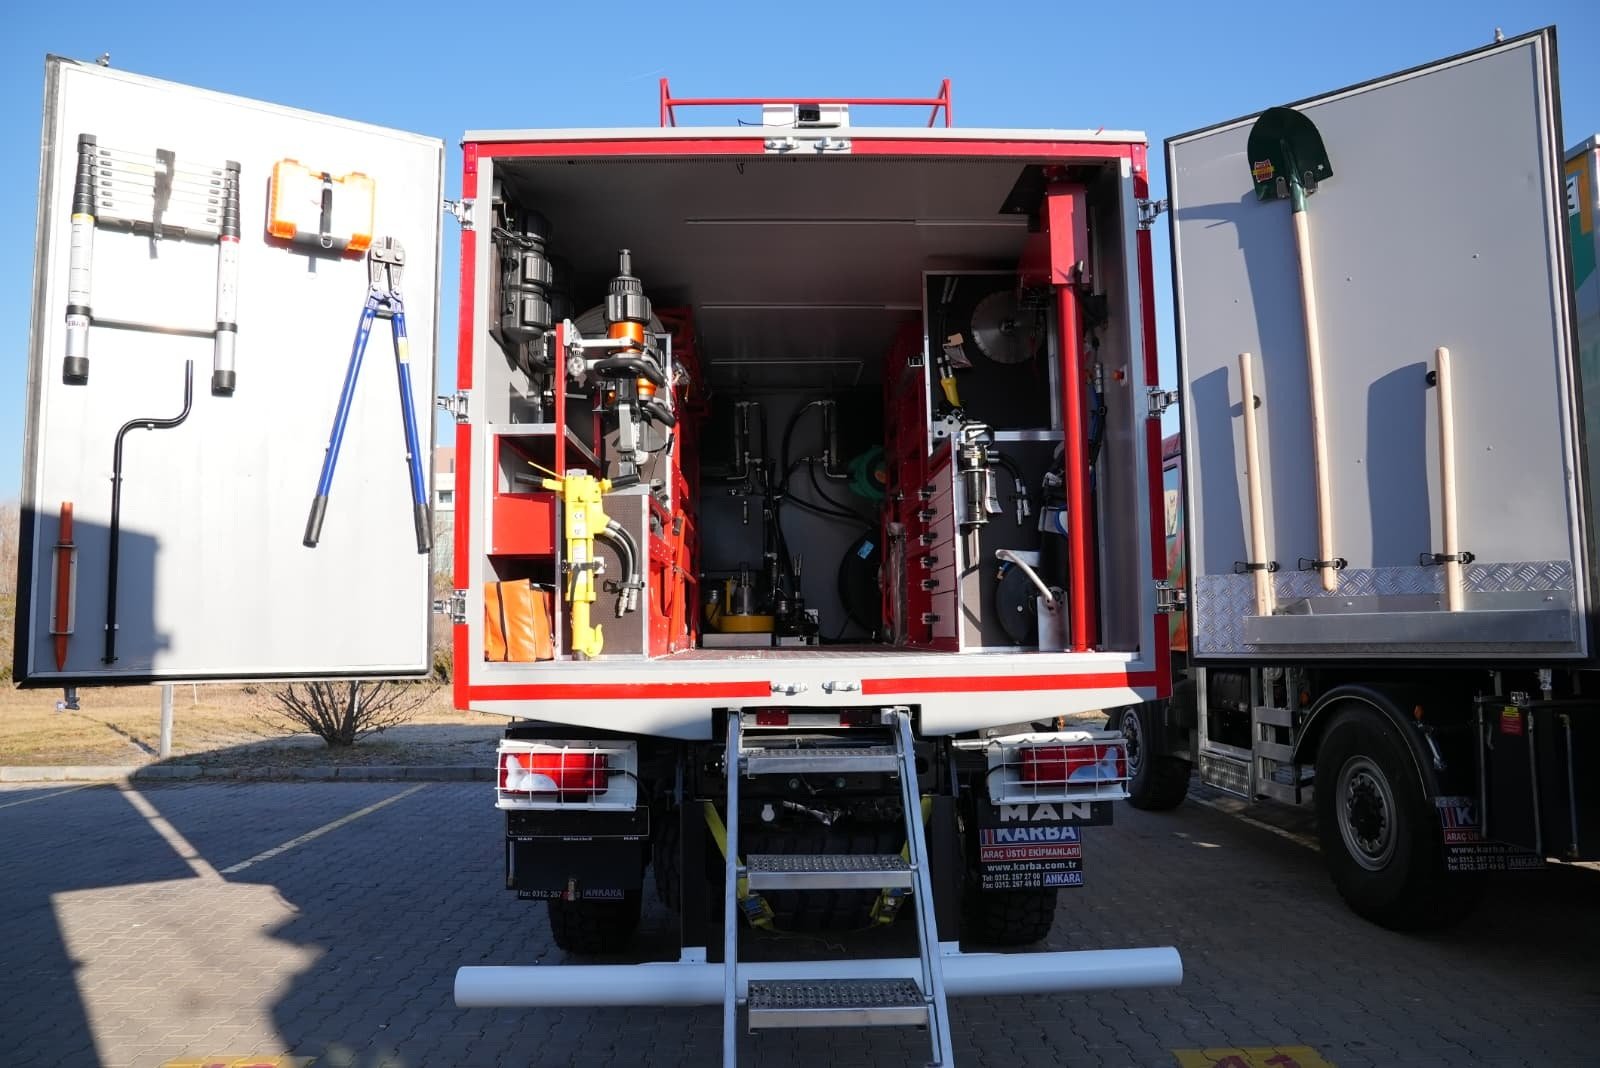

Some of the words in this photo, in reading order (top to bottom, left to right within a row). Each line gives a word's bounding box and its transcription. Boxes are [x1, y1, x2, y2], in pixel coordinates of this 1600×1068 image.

[1000, 803, 1091, 821] MAN
[997, 827, 1076, 841] KARBA
[983, 850, 1004, 859] ARAÇ
[1006, 847, 1026, 857] ÜSTÜ
[1029, 848, 1079, 857] EKİPMANLARI
[987, 861, 1077, 872] www.karba.com.tr
[1045, 873, 1081, 884] ANKARA
